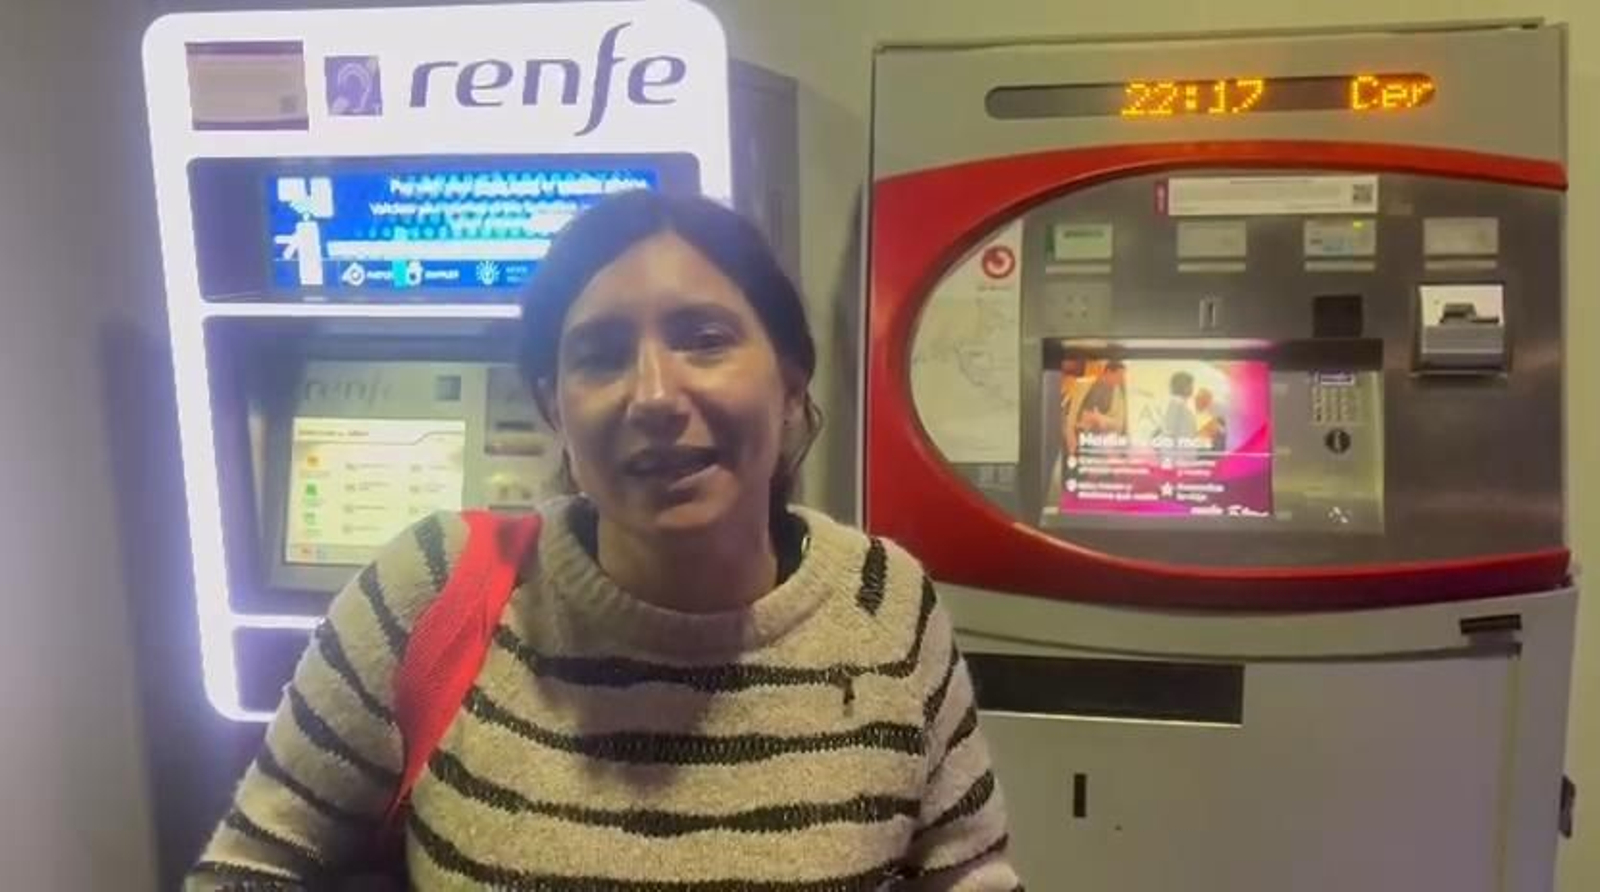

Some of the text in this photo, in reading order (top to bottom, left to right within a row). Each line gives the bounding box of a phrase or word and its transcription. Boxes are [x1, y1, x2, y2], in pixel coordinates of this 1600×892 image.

[408, 21, 687, 137] renfe
[1120, 74, 1434, 115] 22:17 Cer
